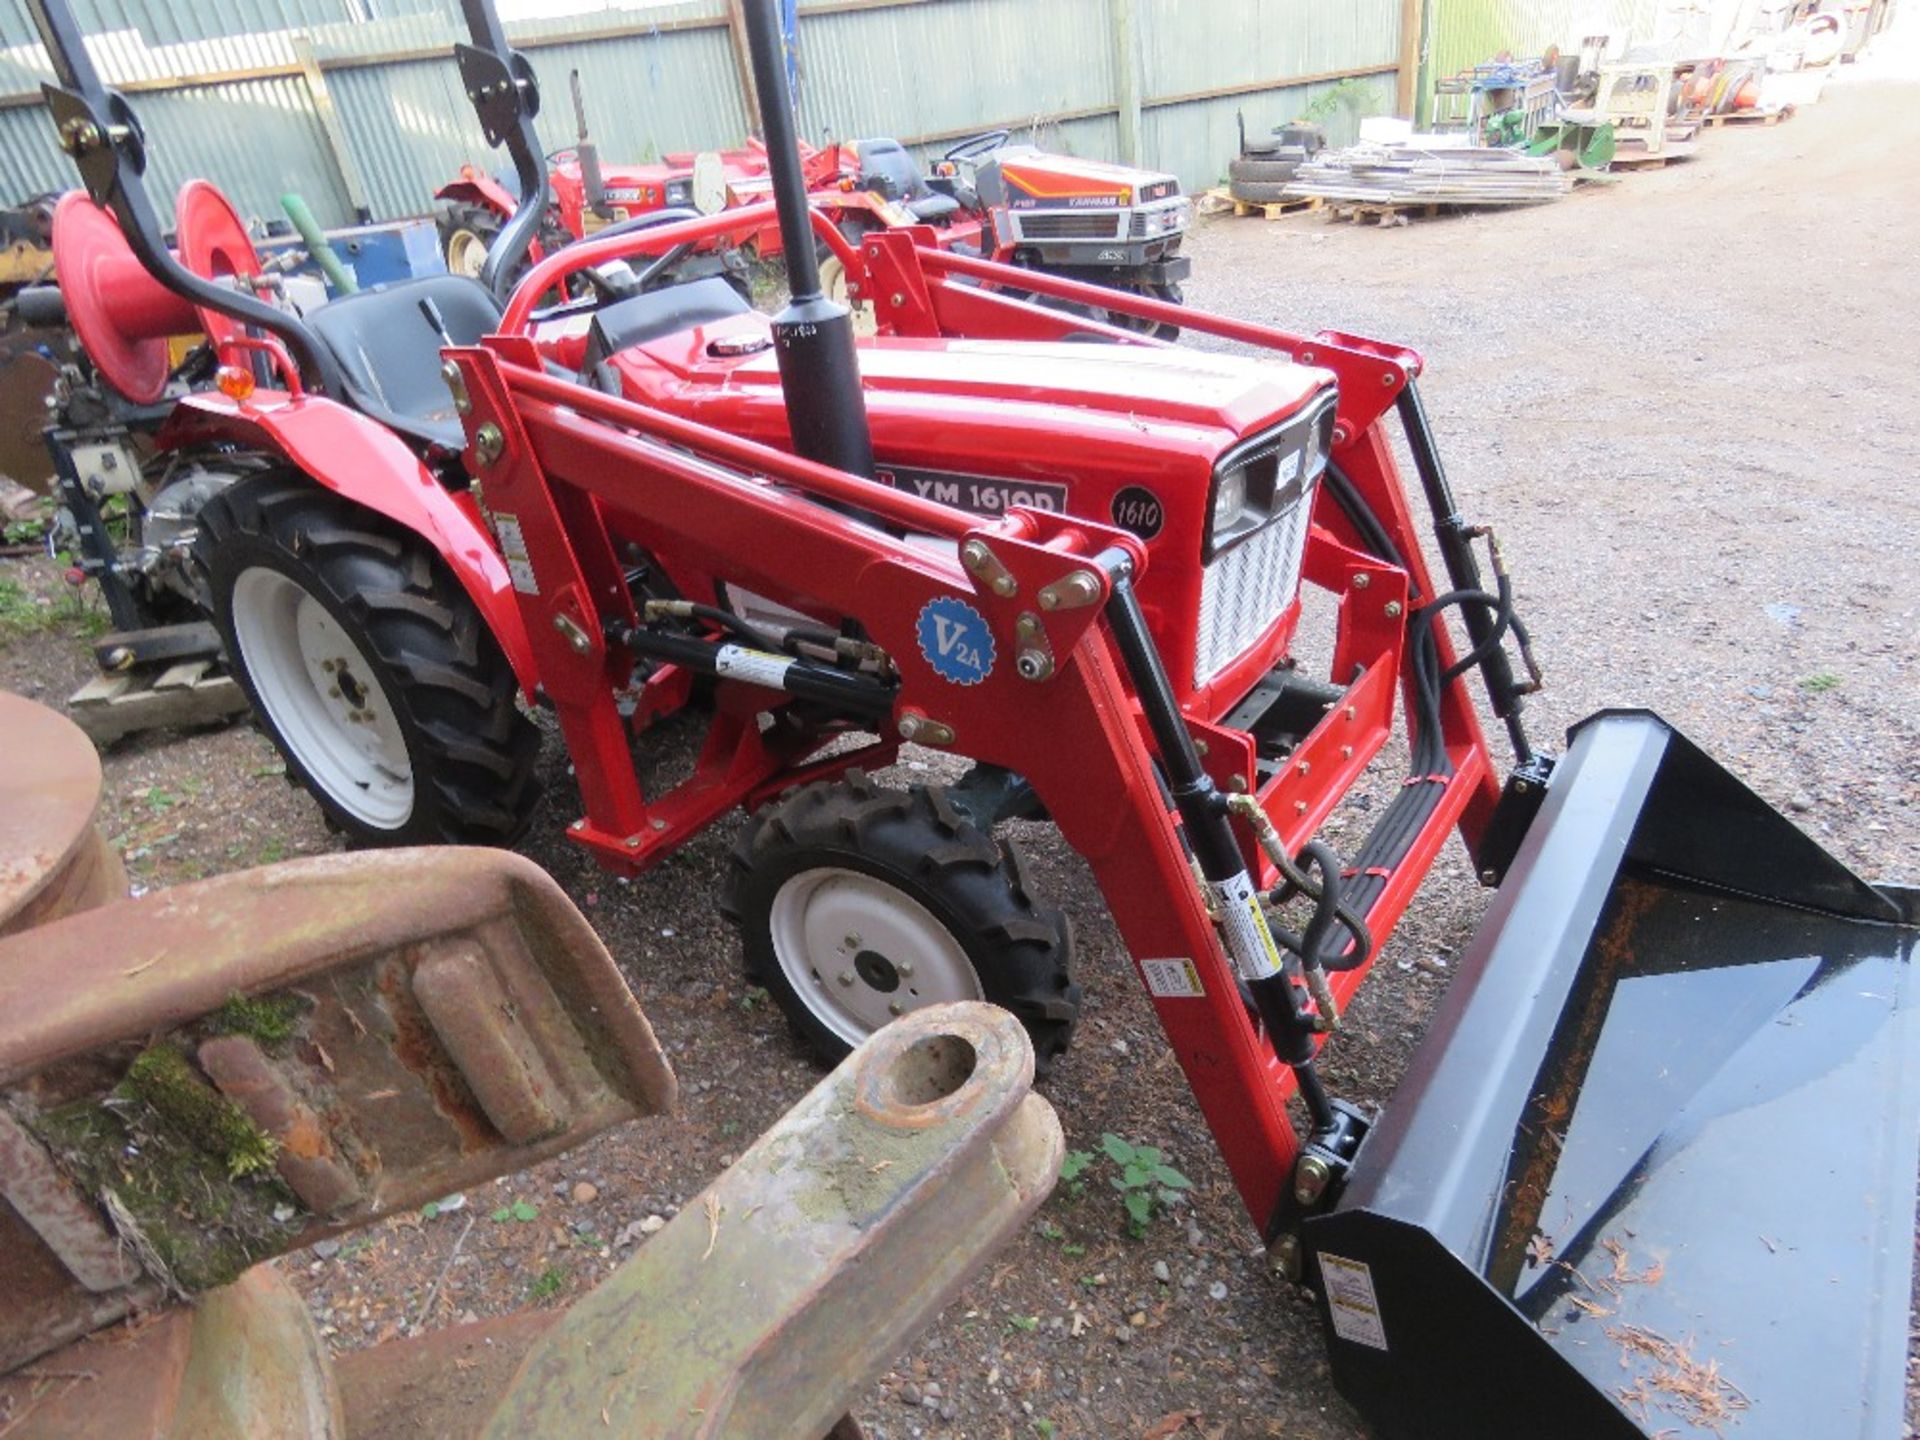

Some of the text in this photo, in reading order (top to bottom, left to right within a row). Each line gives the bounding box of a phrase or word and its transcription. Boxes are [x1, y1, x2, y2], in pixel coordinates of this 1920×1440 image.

[913, 479, 959, 504] YM
[969, 484, 1056, 512] 1610D
[1117, 499, 1159, 527] 1610
